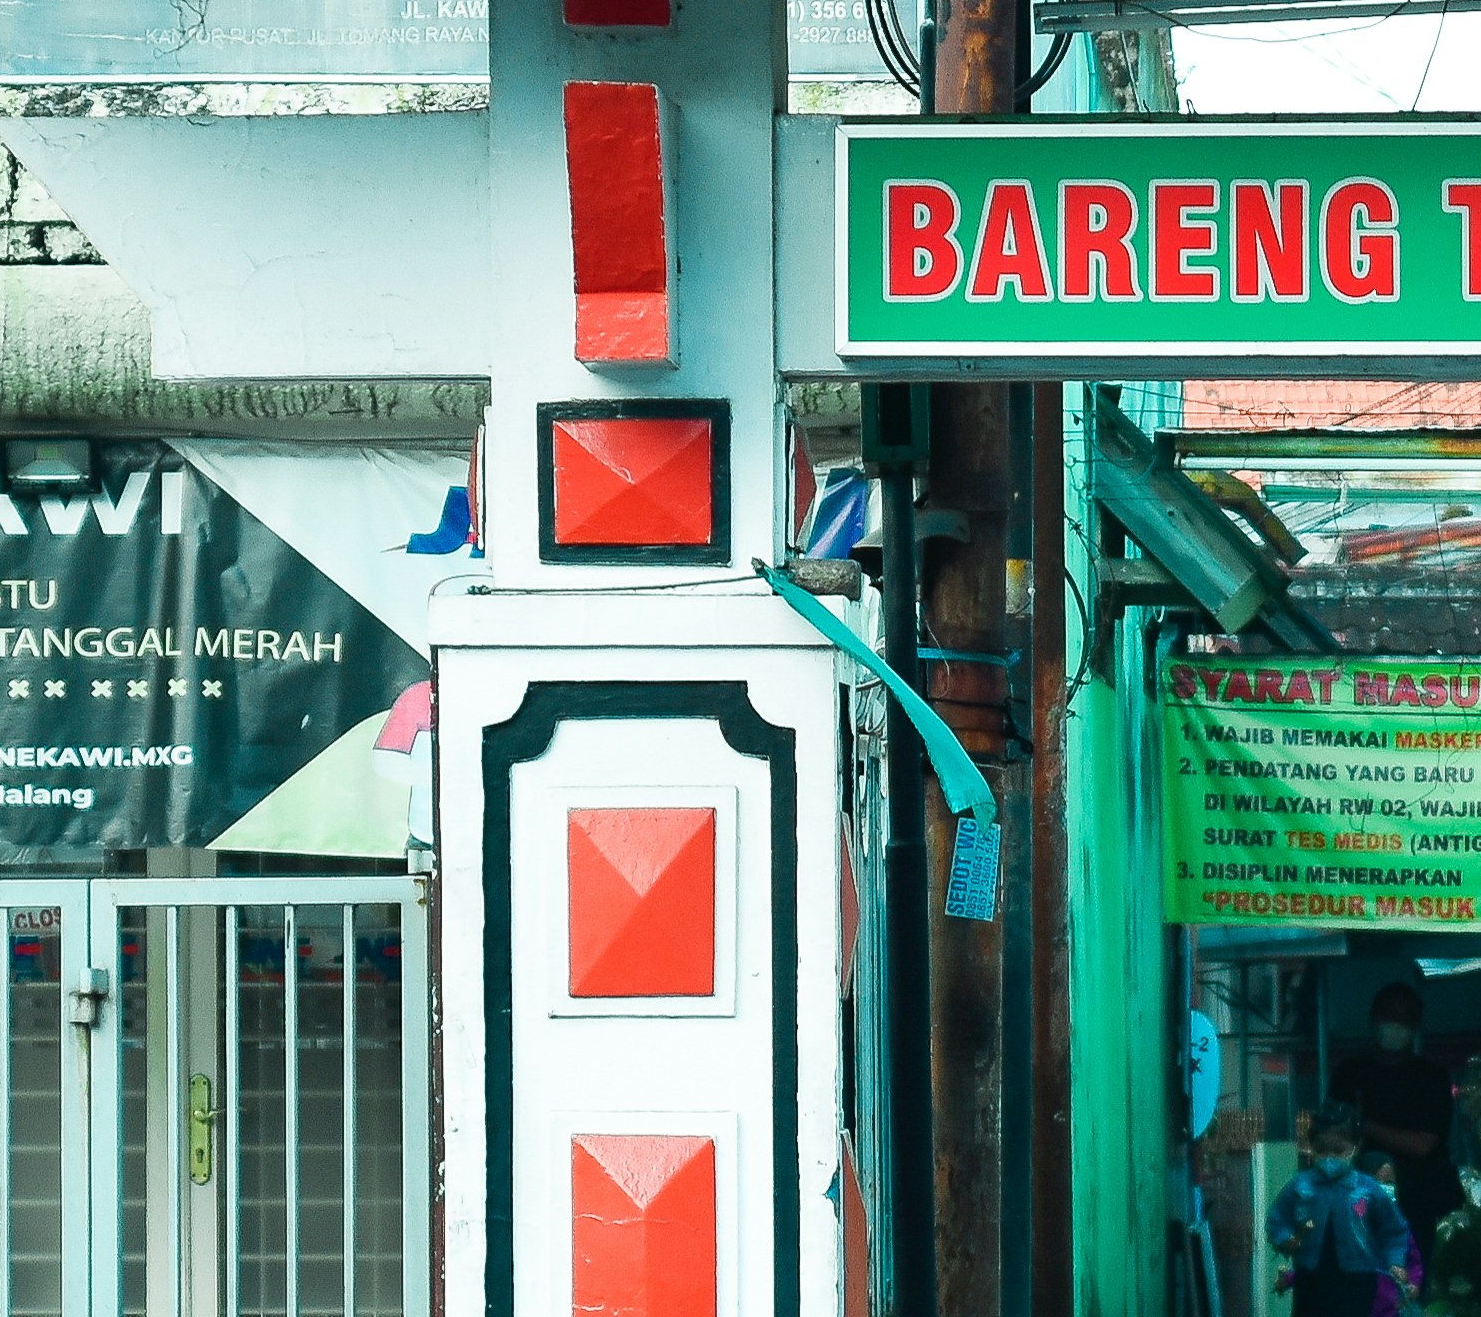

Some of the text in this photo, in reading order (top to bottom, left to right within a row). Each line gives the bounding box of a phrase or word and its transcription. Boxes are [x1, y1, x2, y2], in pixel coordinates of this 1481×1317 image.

[401, 0, 431, 19] JL.
[810, 1, 846, 19] 356
[424, 26, 476, 43] RAYA
[882, 175, 1401, 304] BARENG
[194, 626, 341, 662] MERAH
[1171, 664, 1340, 705] SYARAT
[1205, 724, 1274, 745] WAJIB
[1282, 728, 1387, 748] MEMAKAI
[1179, 758, 1197, 776] 2.
[1205, 759, 1337, 781] PENDATANG
[1345, 764, 1405, 782] YANG
[1414, 766, 1474, 784] BARU
[1204, 794, 1225, 811] DI
[1233, 794, 1331, 815] WILAYAH
[1339, 799, 1374, 816] RW
[1380, 799, 1412, 820] 02,
[1204, 828, 1277, 847] SURAT
[1285, 831, 1327, 850] TES
[1334, 833, 1403, 851] MEDIS
[947, 821, 977, 915] SEDOT WC
[1177, 861, 1461, 887] 3. DISIPLIN MENERAPKAN
[1376, 895, 1474, 919] MASUK
